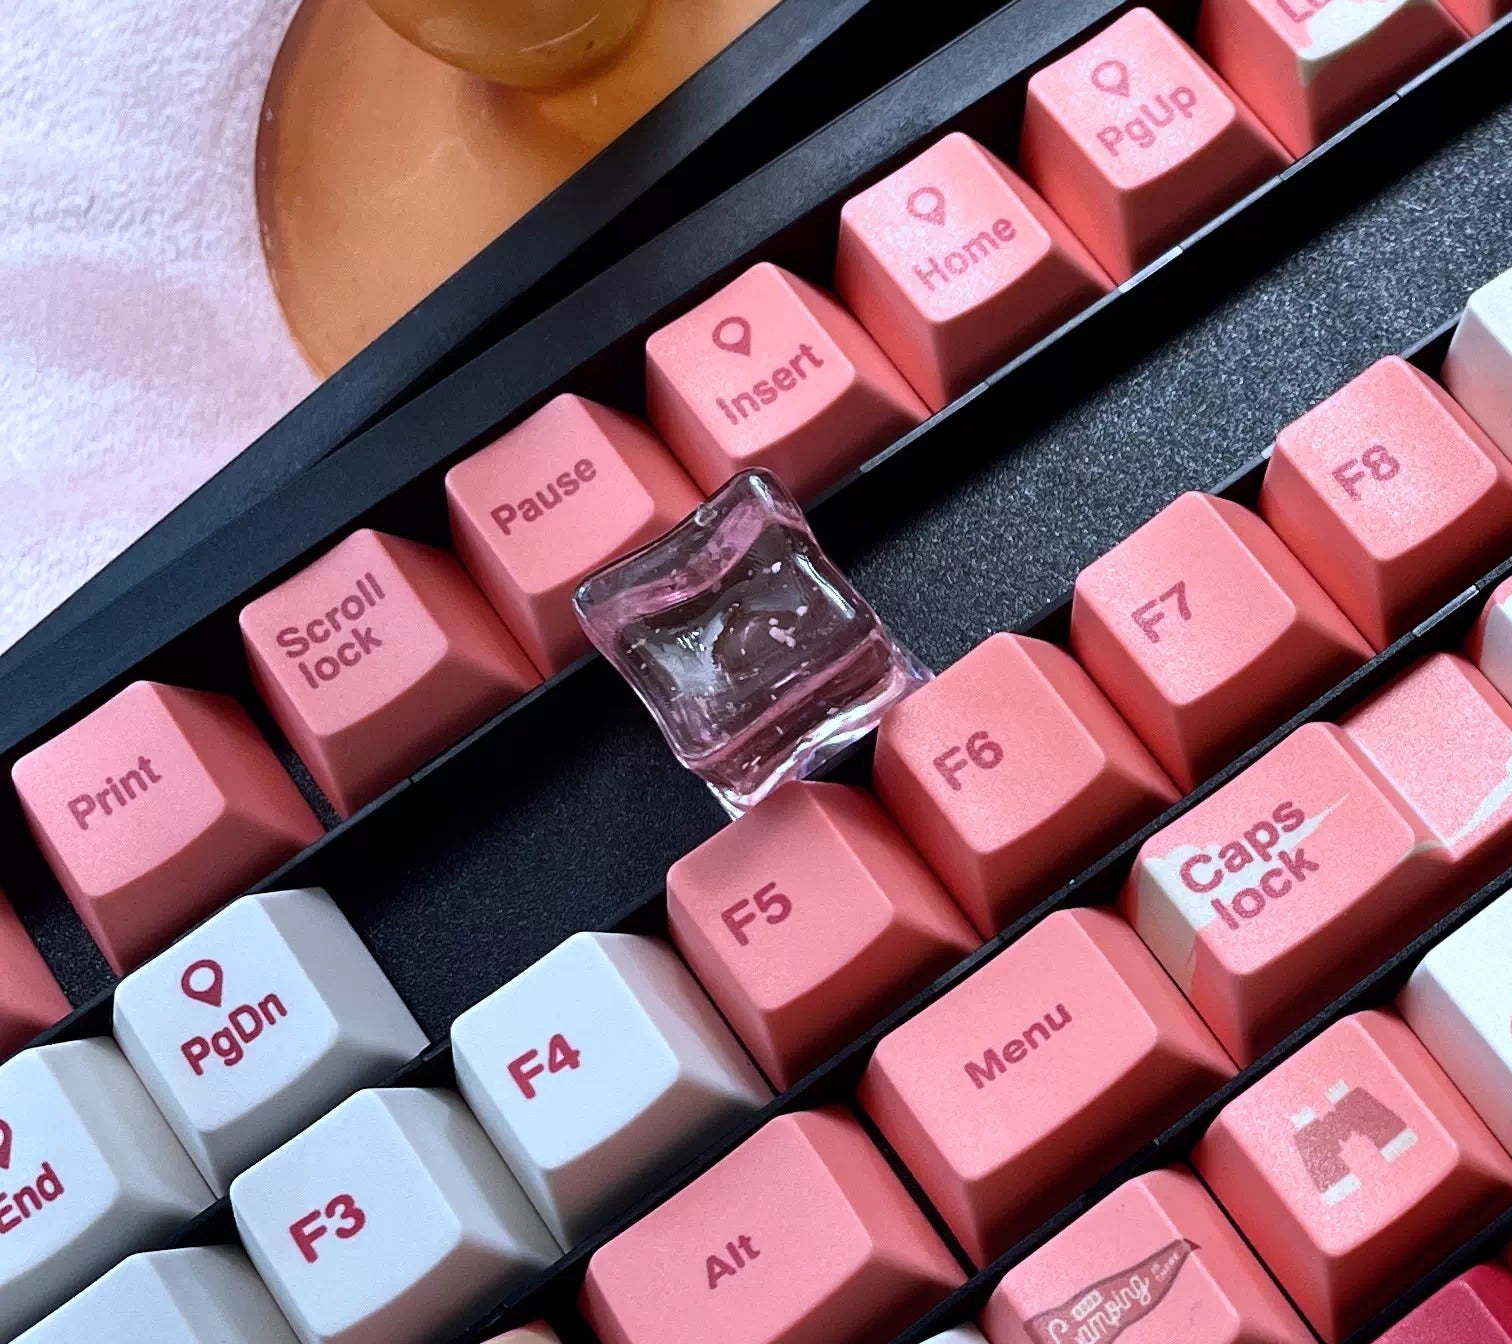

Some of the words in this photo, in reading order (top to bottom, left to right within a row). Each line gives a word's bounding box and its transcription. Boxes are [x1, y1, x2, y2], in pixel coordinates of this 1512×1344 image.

[1095, 84, 1198, 158] PgUp
[911, 215, 1016, 292] Home
[716, 341, 824, 425] Insert
[490, 457, 597, 535] Pause
[1332, 443, 1400, 503] F8
[275, 571, 384, 658] Scroll
[1131, 580, 1192, 645] F7
[298, 621, 382, 690] lock
[67, 754, 162, 830] Print
[933, 731, 1004, 791] F6
[1178, 799, 1307, 895] Caps
[720, 881, 792, 946] F5
[1209, 843, 1320, 930] lock
[181, 990, 288, 1076] PgDn
[506, 1033, 581, 1099] F4
[963, 999, 1073, 1090] Menu
[290, 1193, 367, 1263] F3
[705, 1234, 762, 1289] Alt
